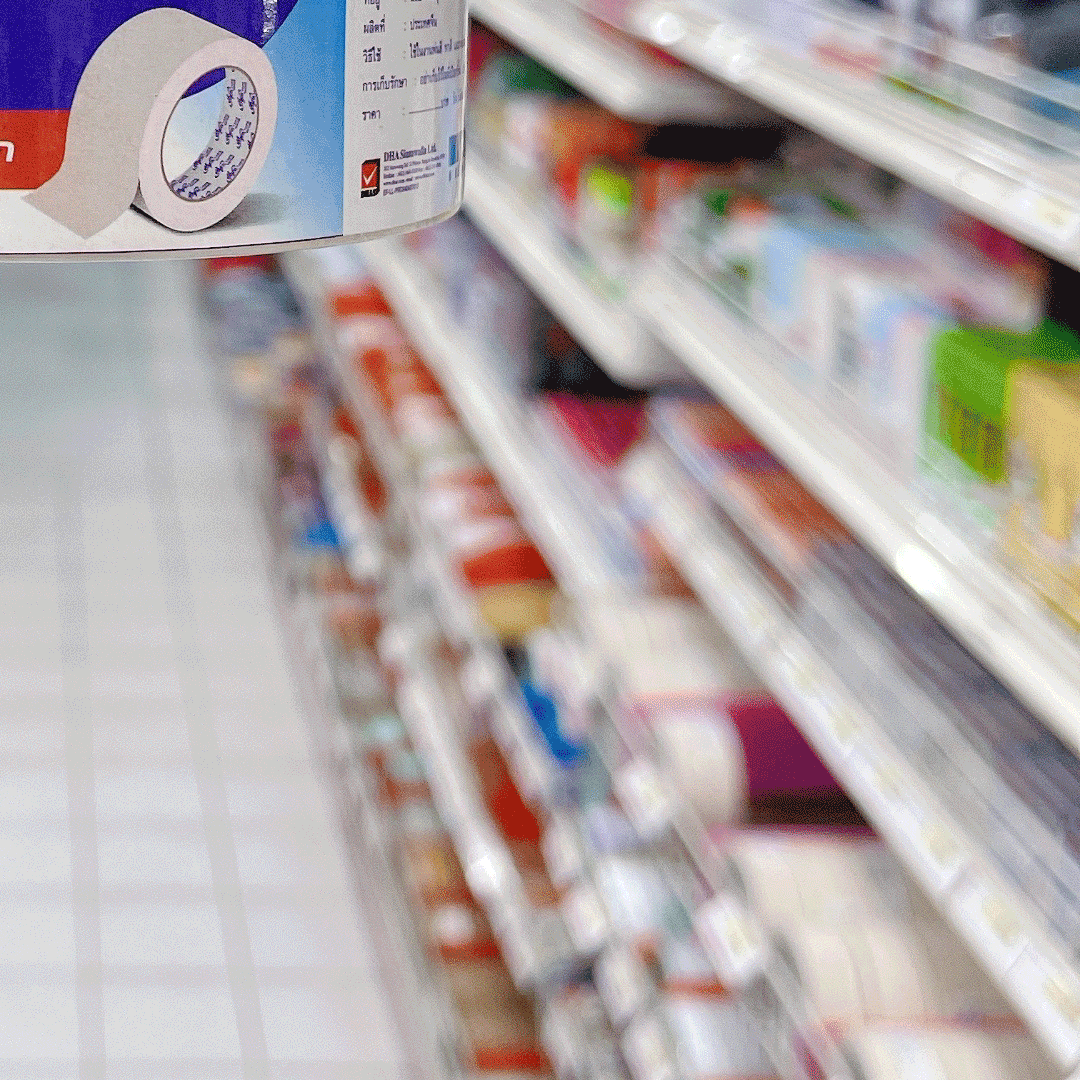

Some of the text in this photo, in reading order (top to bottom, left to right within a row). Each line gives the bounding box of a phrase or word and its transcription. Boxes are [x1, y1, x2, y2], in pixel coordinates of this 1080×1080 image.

[362, 75, 408, 91] การเก็บรักษา
[361, 109, 381, 121] ราคา
